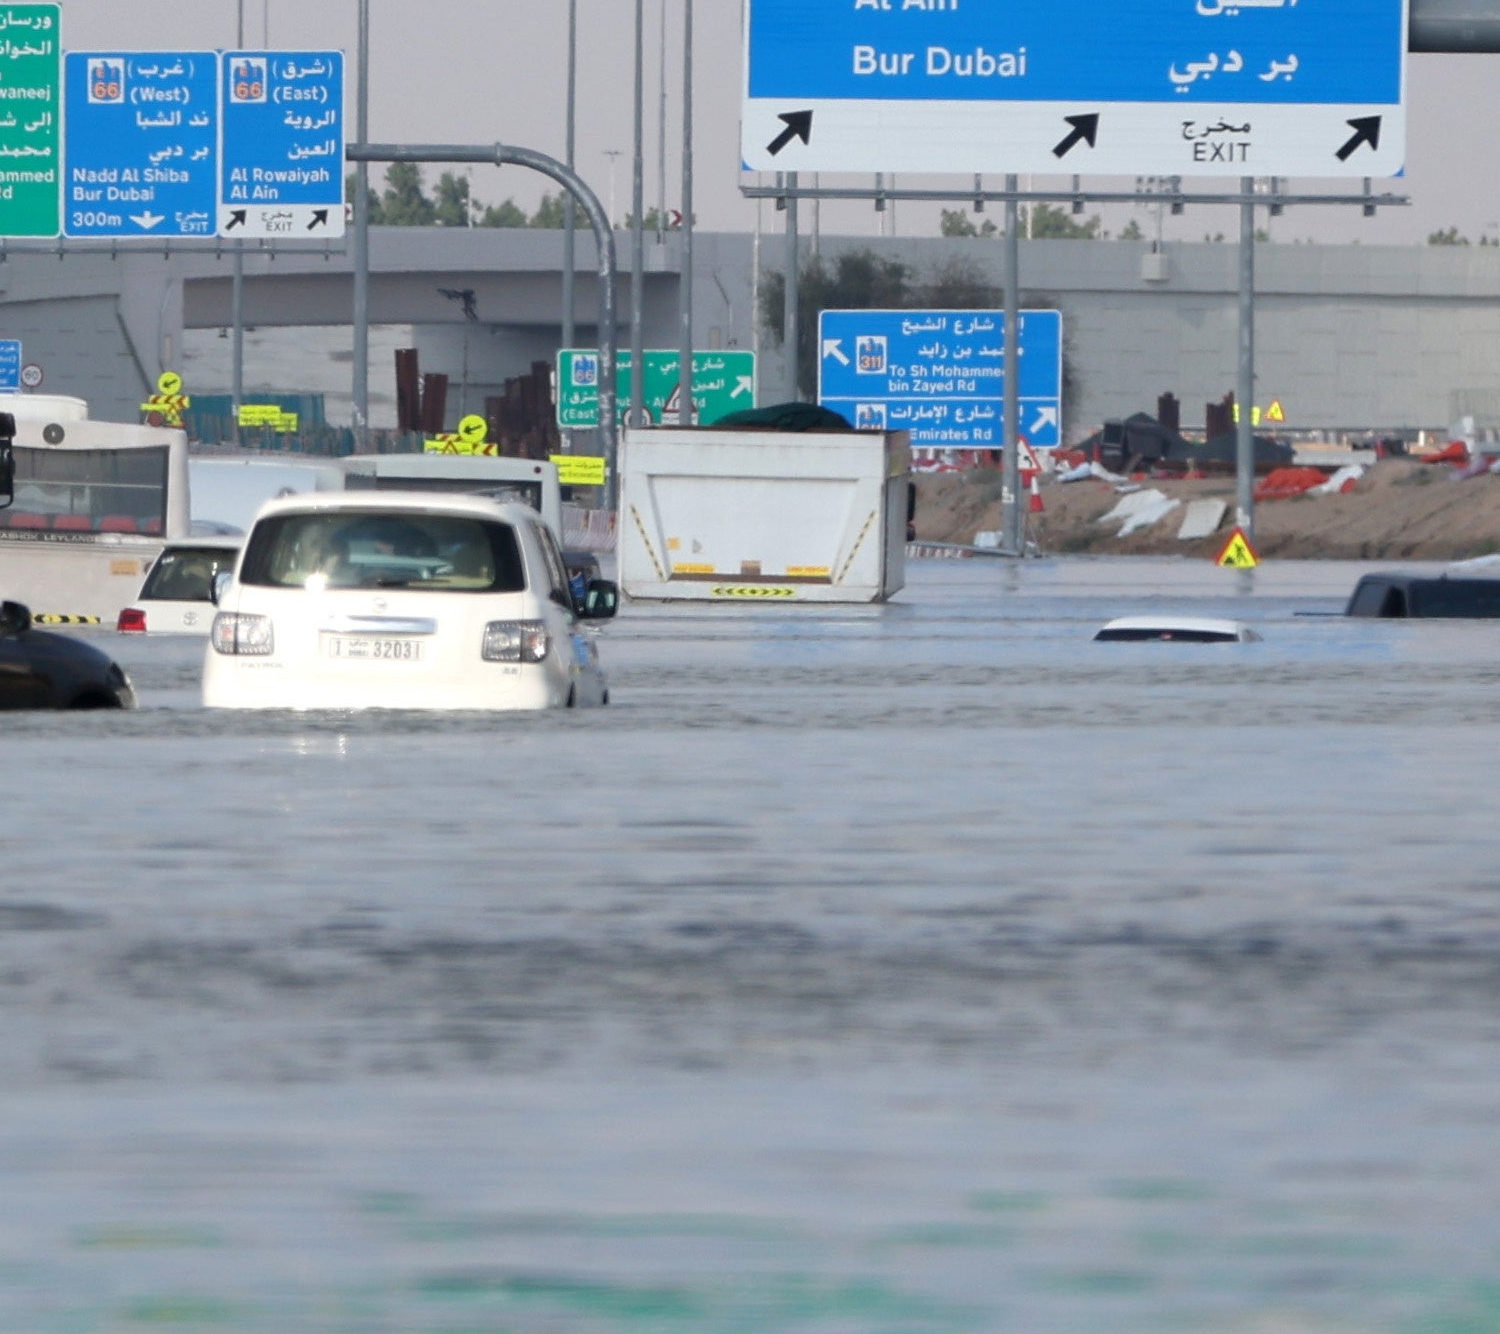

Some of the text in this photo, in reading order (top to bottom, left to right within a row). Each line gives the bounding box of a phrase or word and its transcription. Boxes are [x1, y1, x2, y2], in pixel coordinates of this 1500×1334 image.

[852, 45, 1027, 77] Bur Dubai
[1168, 48, 1299, 94] بر دبي
[93, 82, 120, 99] 66
[130, 86, 190, 104] (West)
[236, 82, 262, 99] 66
[273, 86, 328, 104] (East)
[24, 112, 52, 134] إلى
[135, 110, 210, 127] ند الشبا
[283, 110, 336, 129] الروية
[1181, 117, 1253, 140] مخرج
[149, 145, 210, 166] بر دبي
[287, 140, 336, 160] العين
[1193, 142, 1252, 163] EXIT
[72, 168, 189, 183] Nadd Al Shiba
[230, 168, 330, 185] Al Rowaiyah
[72, 186, 155, 202] Bur Dubai
[230, 185, 278, 199] Al Ain
[72, 212, 122, 227] 300m
[181, 221, 208, 232] EXIT
[266, 221, 293, 232] EXIT
[901, 317, 946, 336] الشيخ
[954, 318, 995, 336] شارع
[918, 342, 972, 360] بن زايد
[889, 365, 1005, 378] To Sh Mohamme
[888, 380, 976, 395] bin Zayed Rd
[954, 404, 995, 423] شارع
[910, 428, 993, 441] Emirates Rd
[0, 532, 96, 544] ASHOK LEYLAND
[373, 641, 420, 659] 32031
